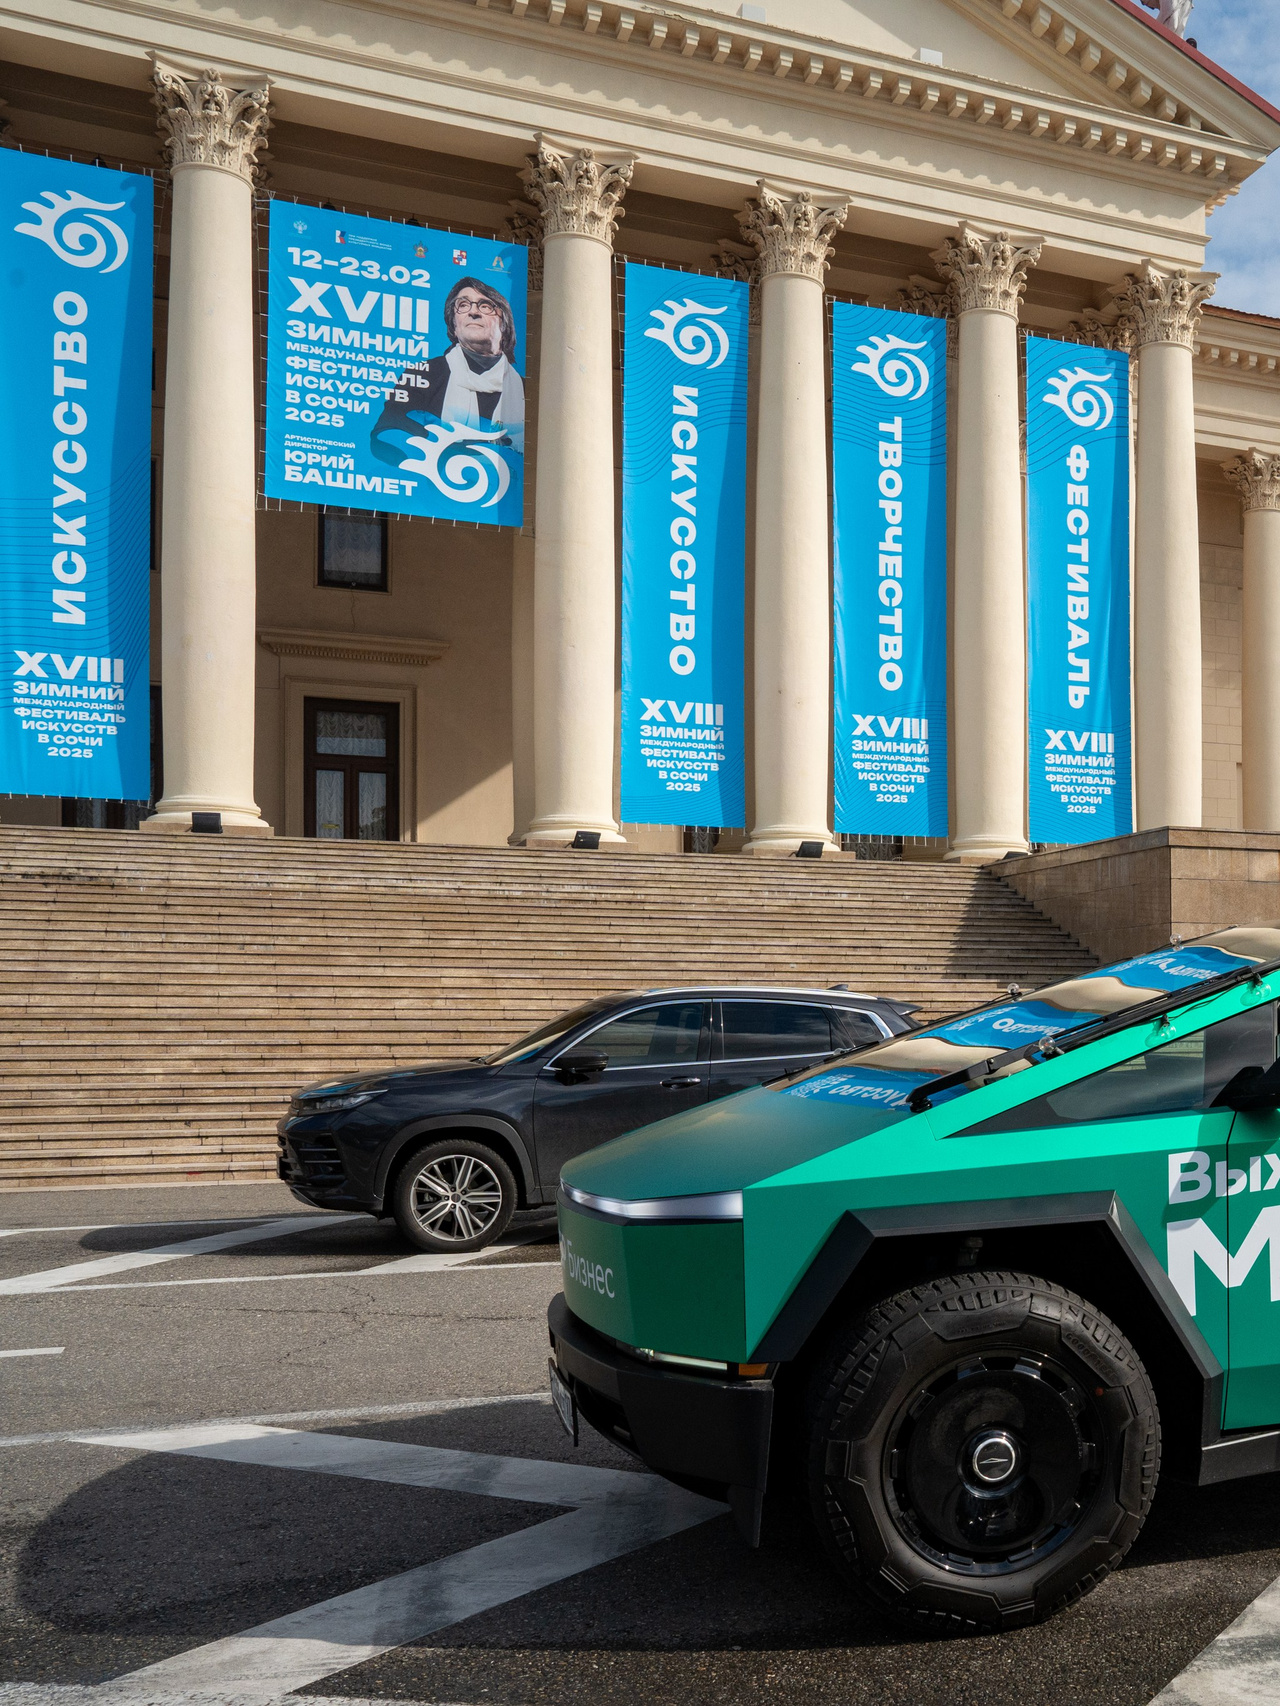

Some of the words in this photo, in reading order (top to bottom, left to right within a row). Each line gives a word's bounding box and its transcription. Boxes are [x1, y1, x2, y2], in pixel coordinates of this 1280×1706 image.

[286, 276, 429, 334] XVIII
[286, 319, 429, 358] ЗИМНИЙ
[286, 341, 430, 372] МЕЖДУНАРОДНЫЙ
[285, 355, 430, 389] ФЕСТИВАЛЬ
[285, 372, 410, 403] ИСКУССТВ
[285, 389, 304, 404] В
[305, 392, 370, 415] СОЧИ
[285, 407, 345, 428] 2025
[284, 433, 355, 449] АРТИСТИЧЕСКИЙ
[284, 440, 328, 451] ДИРЕКТОР
[52, 290, 88, 626] ИСКУССТВО
[284, 449, 354, 471] ЮРИЙ
[284, 464, 418, 497] БАШМЕТ
[669, 384, 699, 676] ИСКУССТВО
[878, 415, 904, 692] ТВОРЧЕСТВО
[1066, 444, 1091, 709] ФЕСТИВАЛЬ
[13, 650, 124, 683] XVIII
[13, 681, 124, 701] ЗИМНИЙ
[13, 697, 125, 710] МЕЖДУНАРОДНЫЙ
[14, 707, 126, 723] ФЕСТИВАЛЬ
[640, 698, 723, 726] XVIII
[22, 720, 118, 735] ИСКУССТВ
[640, 725, 724, 741] ЗИМНИЙ
[851, 714, 928, 740] XVIII
[37, 733, 50, 743] В
[53, 735, 103, 746] СОЧИ
[640, 739, 724, 750] МЕЖДУНАРОДНЫЙ
[851, 740, 929, 754] ЗИМНИЙ
[1044, 729, 1115, 753] XVIII
[47, 747, 93, 758] 2025
[640, 747, 725, 761] ФЕСТИВАЛЬ
[852, 753, 929, 763] МЕЖДУНАРОДНЫЙ
[1044, 753, 1115, 767] ЗИМНИЙ
[646, 759, 719, 771] ИСКУССТВ
[852, 761, 930, 773] ФЕСТИВАЛЬ
[1045, 766, 1115, 775] МЕЖДУНАРОДНЫЙ
[658, 771, 668, 779] В
[670, 771, 708, 781] СОЧИ
[858, 772, 925, 783] ИСКУССТВ
[1045, 774, 1117, 785] ФЕСТИВАЛЬ
[666, 782, 701, 792] 2025
[869, 783, 878, 791] В
[880, 784, 915, 793] СОЧИ
[1050, 784, 1111, 795] ИСКУССТВ
[876, 794, 908, 803] 2025
[1060, 795, 1069, 803] В
[1070, 795, 1102, 804] СОЧИ
[1067, 805, 1096, 814] 2025
[566, 1239, 615, 1298] Бизнес
